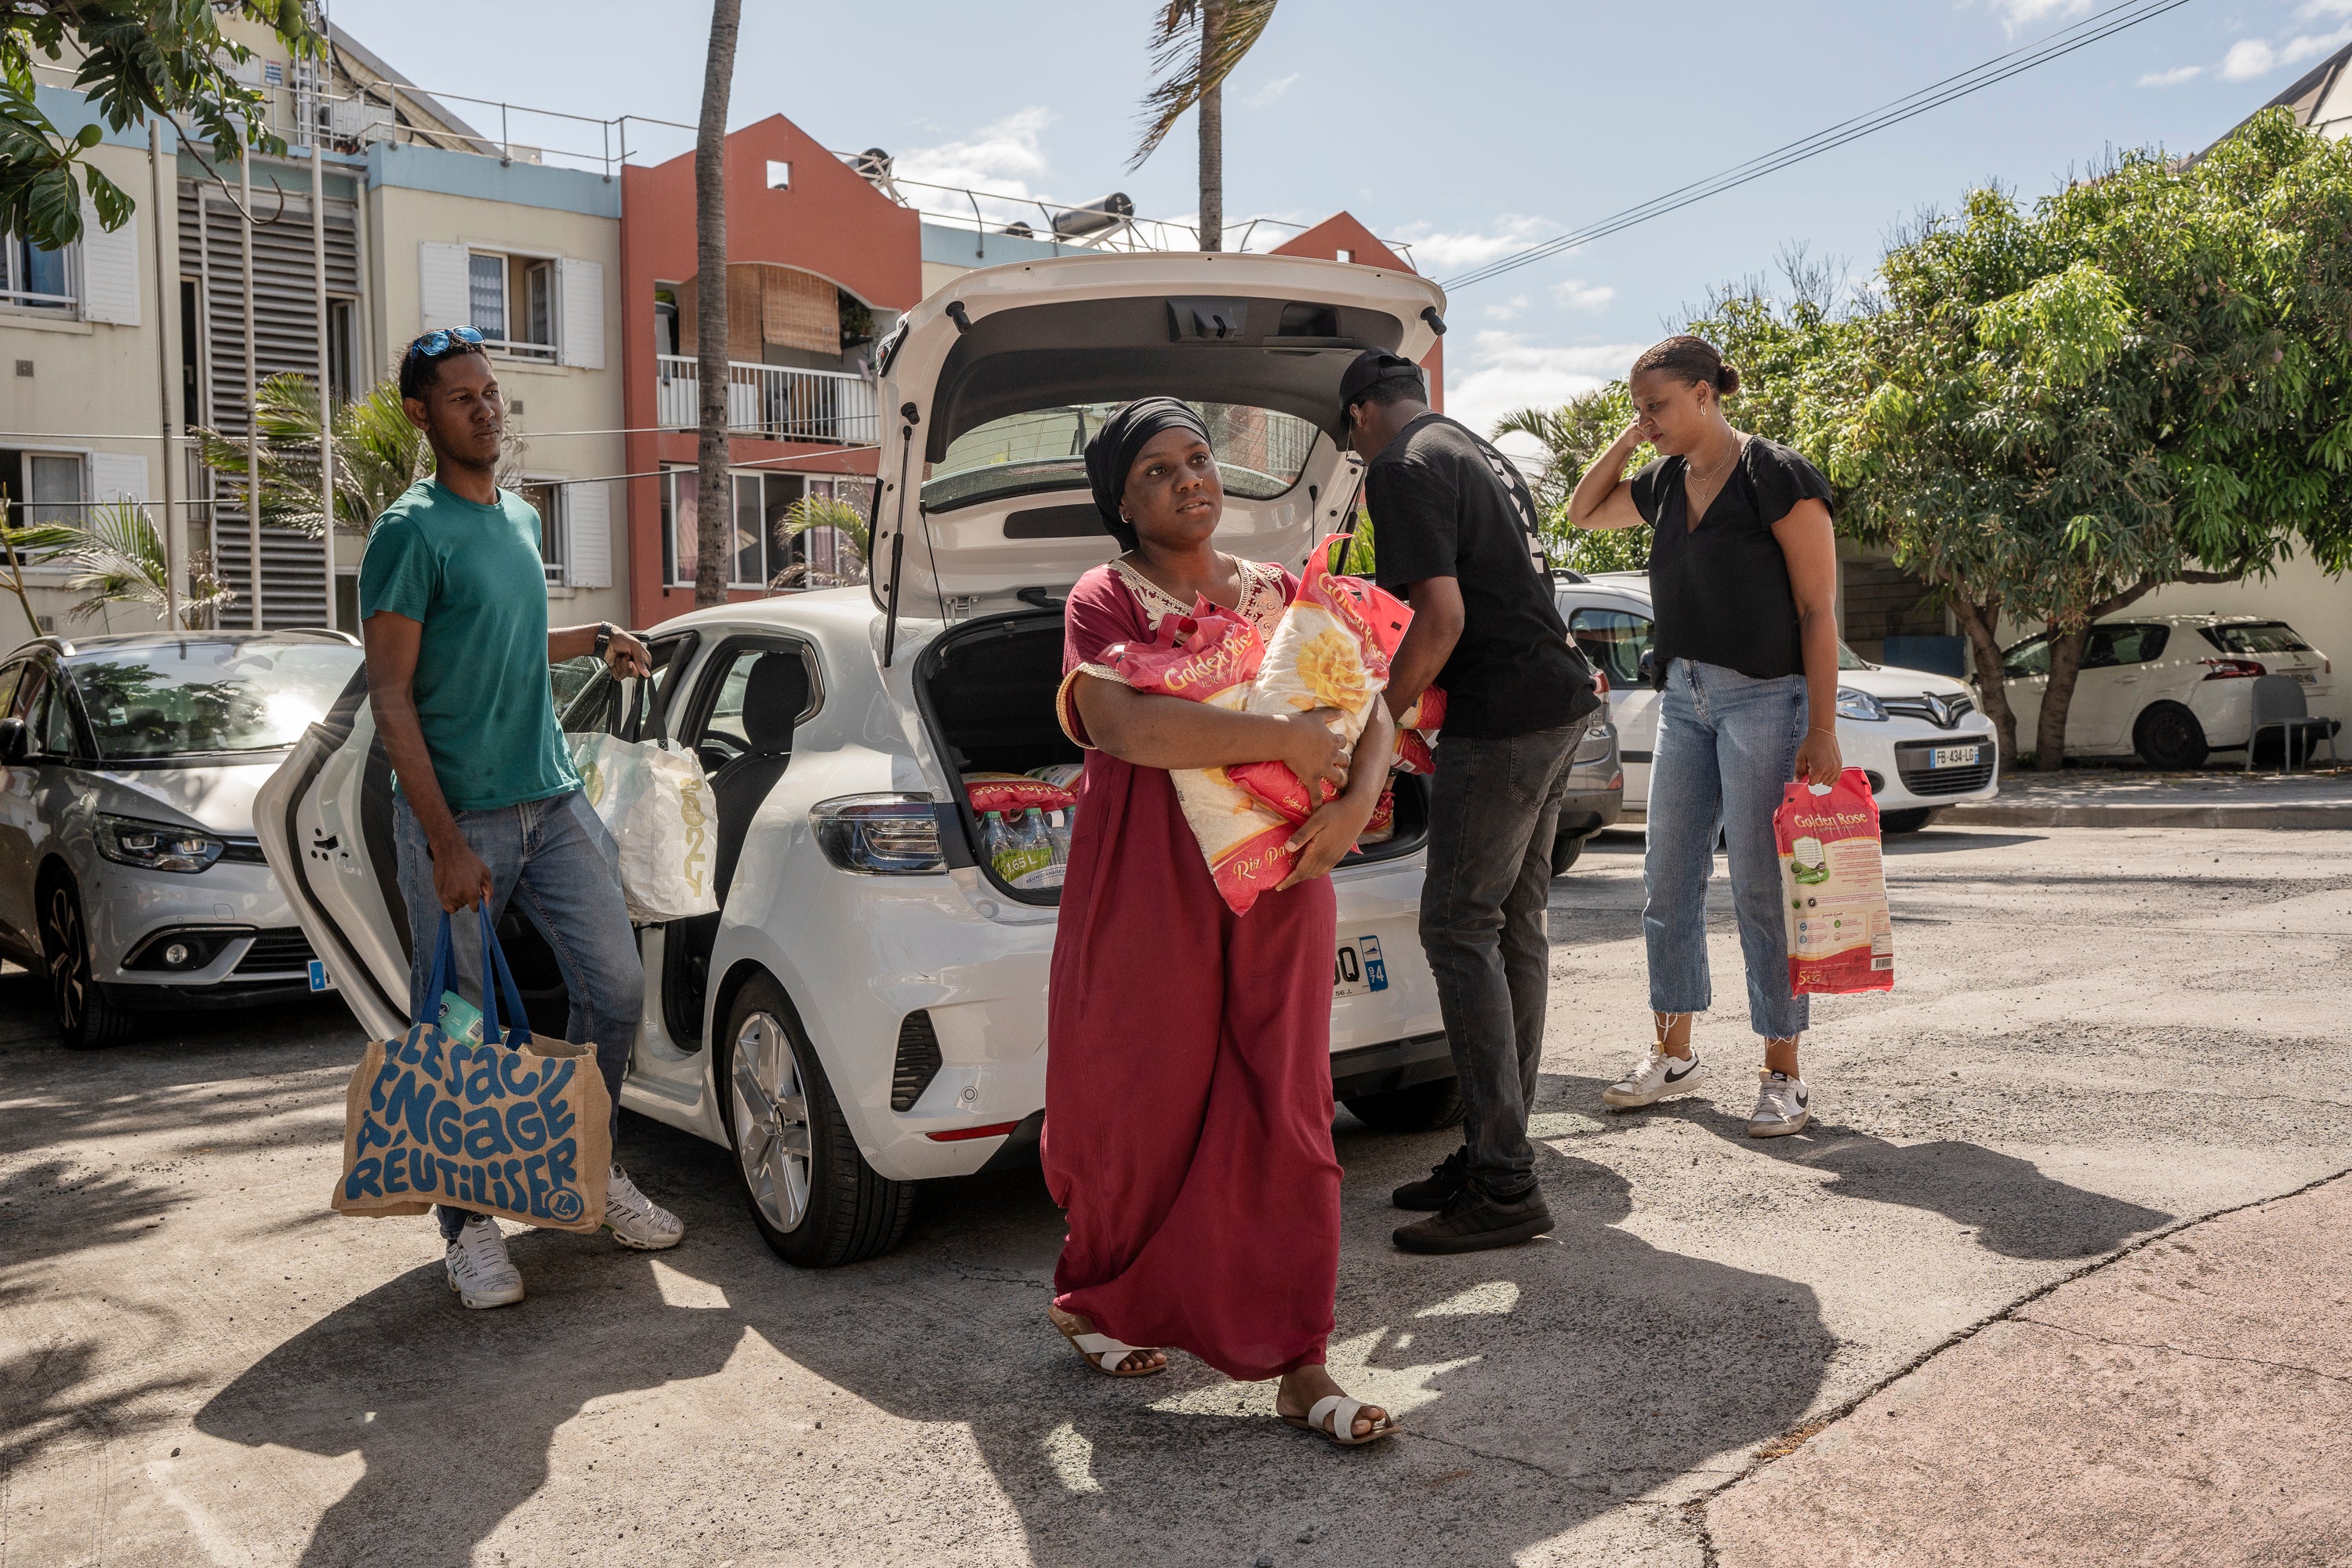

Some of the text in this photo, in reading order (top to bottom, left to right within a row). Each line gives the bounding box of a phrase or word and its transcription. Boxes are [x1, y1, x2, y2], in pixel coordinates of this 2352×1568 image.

[1163, 654, 1231, 691] Golden
[1937, 748, 1974, 764] FB-434-LG
[1301, 806, 1312, 816] Ros
[1794, 812, 1868, 828] Golden Rose
[1233, 858, 1263, 881] Riz
